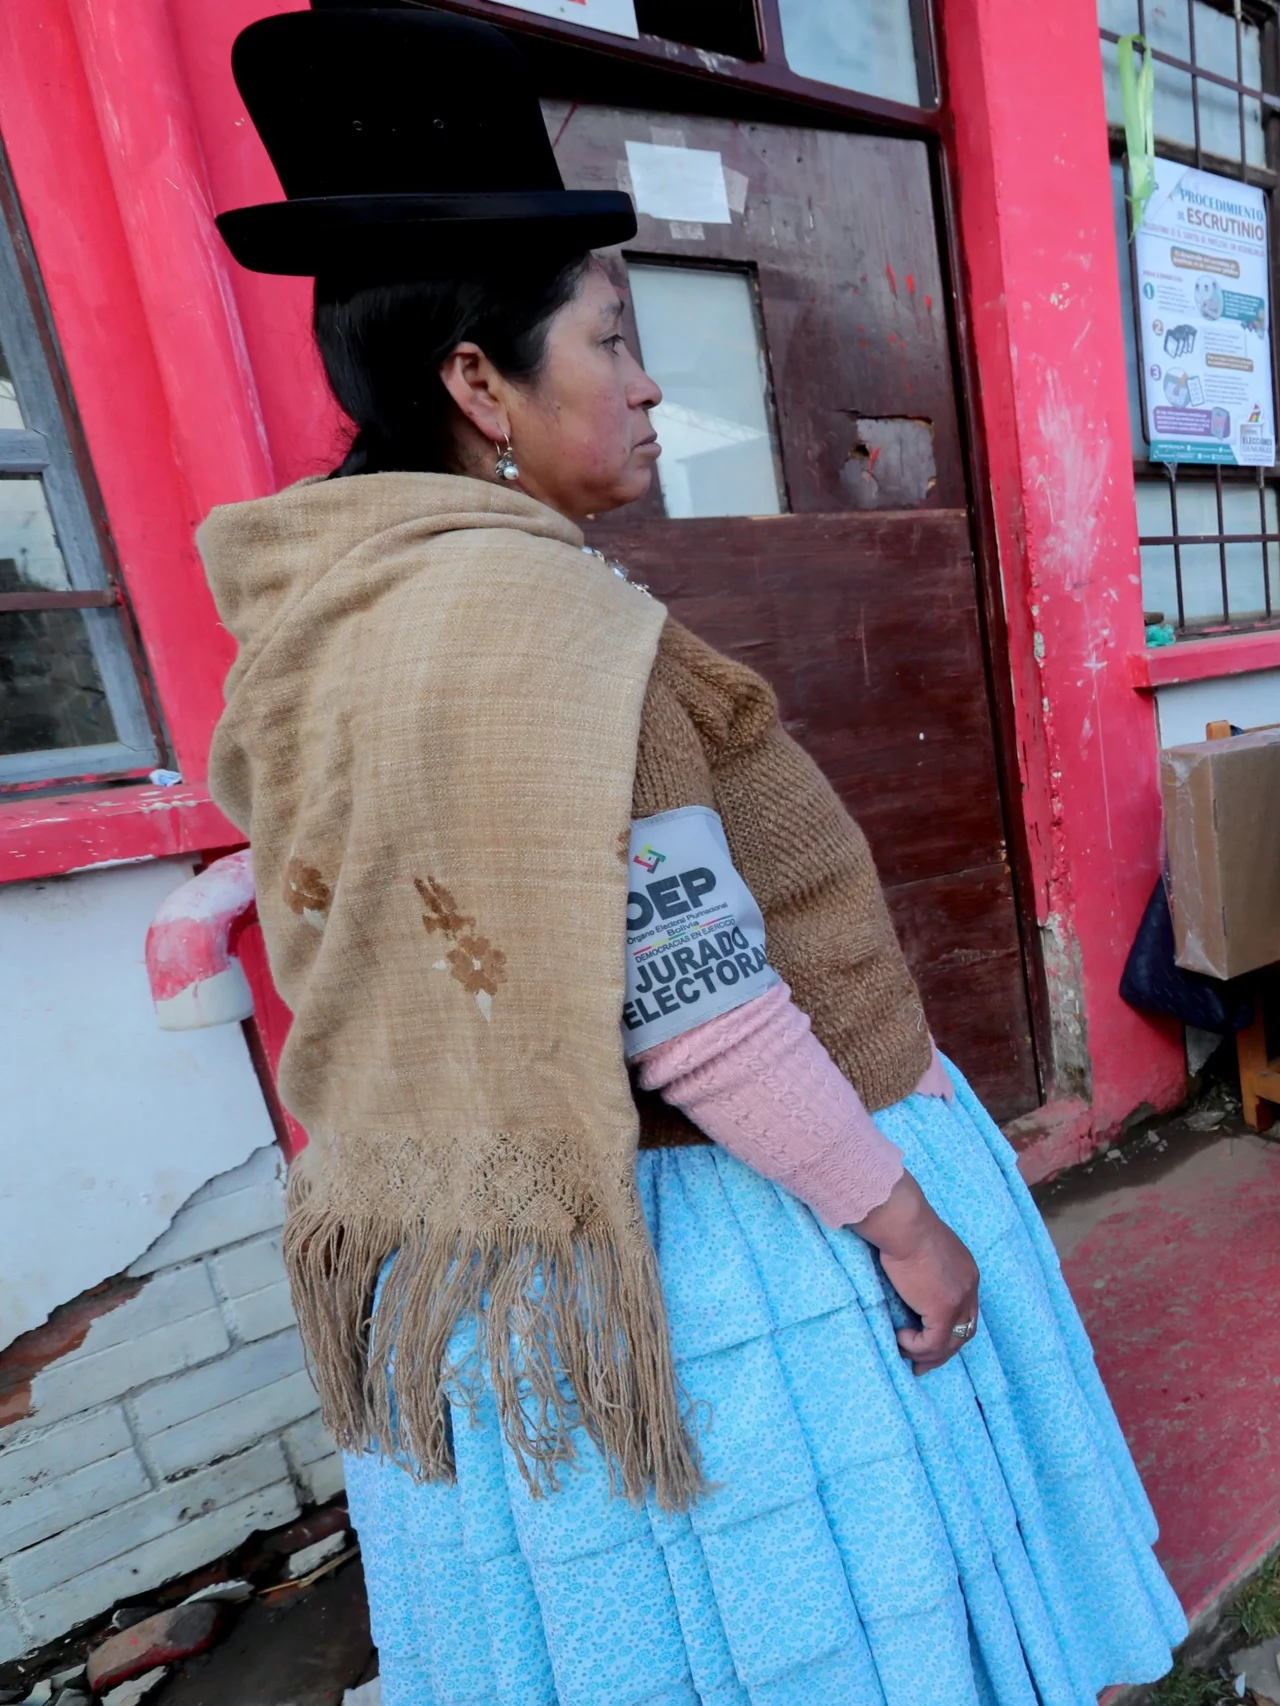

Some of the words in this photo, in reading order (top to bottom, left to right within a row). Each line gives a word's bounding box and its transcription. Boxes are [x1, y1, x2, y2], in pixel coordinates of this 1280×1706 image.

[1180, 189, 1264, 222] PROCEDIMIENTO
[1187, 207, 1264, 241] ESCRUTINIO
[626, 867, 717, 931] OEP
[655, 917, 686, 933] Electoral
[686, 902, 729, 923] Plurinacional
[635, 936, 690, 963] DEMOCRACIAS
[691, 931, 702, 940] EN
[703, 918, 736, 936] EJERCICIO
[667, 920, 700, 936] Bolivia
[635, 926, 750, 994] JURADO
[622, 943, 767, 1031] ELECTORA
